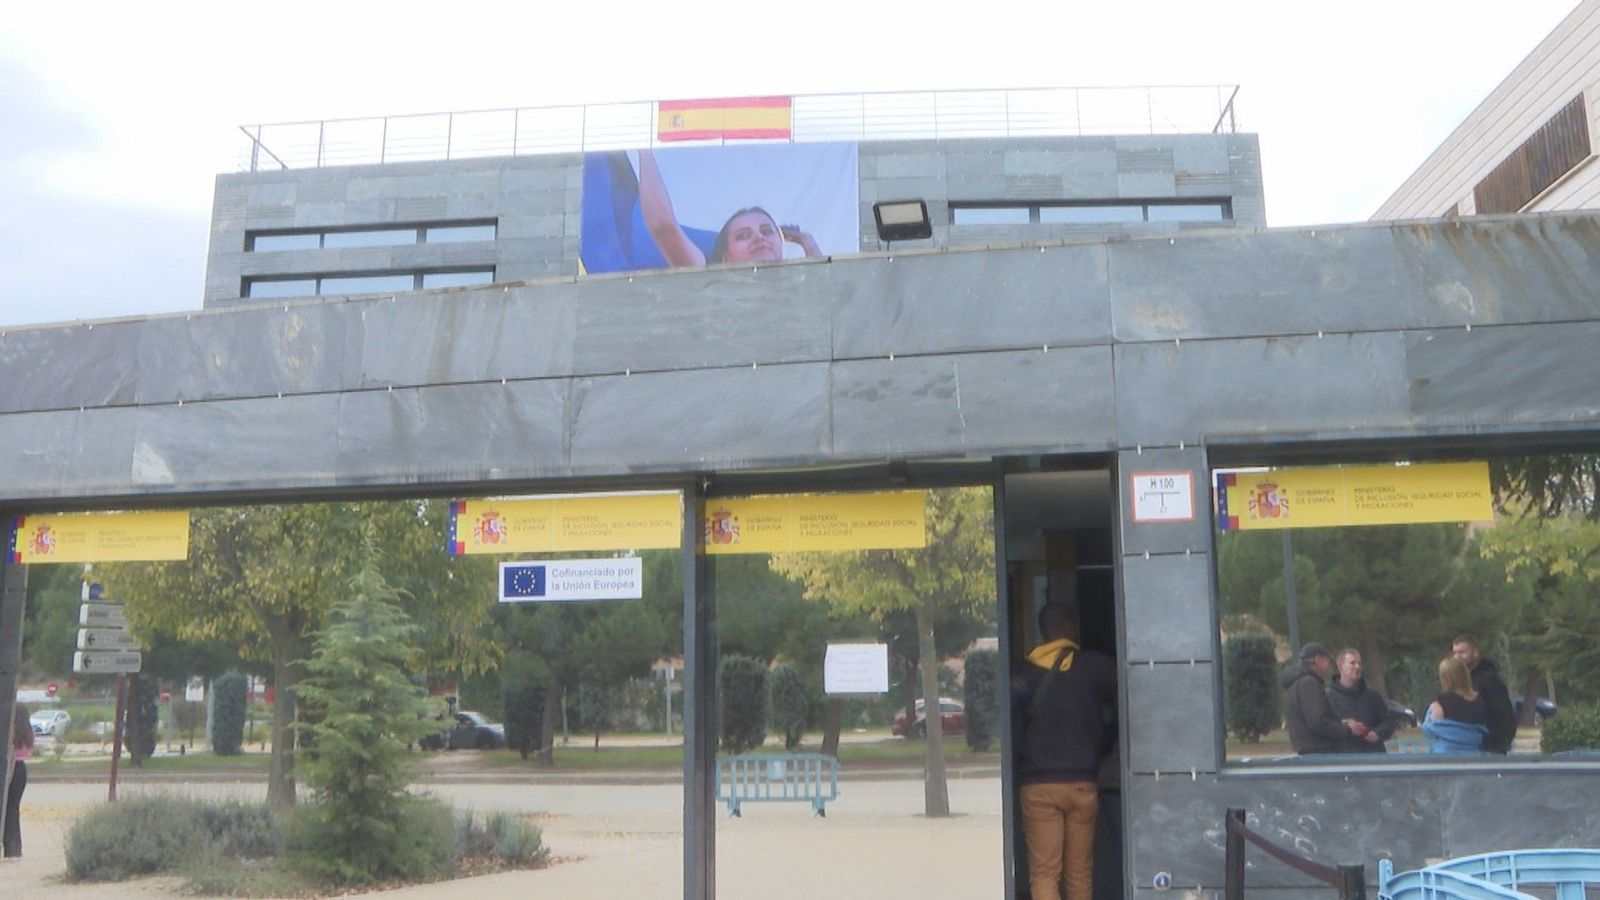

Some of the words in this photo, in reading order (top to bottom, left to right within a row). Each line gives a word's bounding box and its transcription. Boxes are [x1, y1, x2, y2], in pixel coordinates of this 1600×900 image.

[1150, 478, 1157, 488] H
[1160, 478, 1174, 488] 100
[552, 567, 615, 577] Cofinanciado
[618, 568, 634, 578] por
[552, 582, 560, 591] la
[562, 580, 591, 591] Unión
[594, 580, 634, 591] Europea
